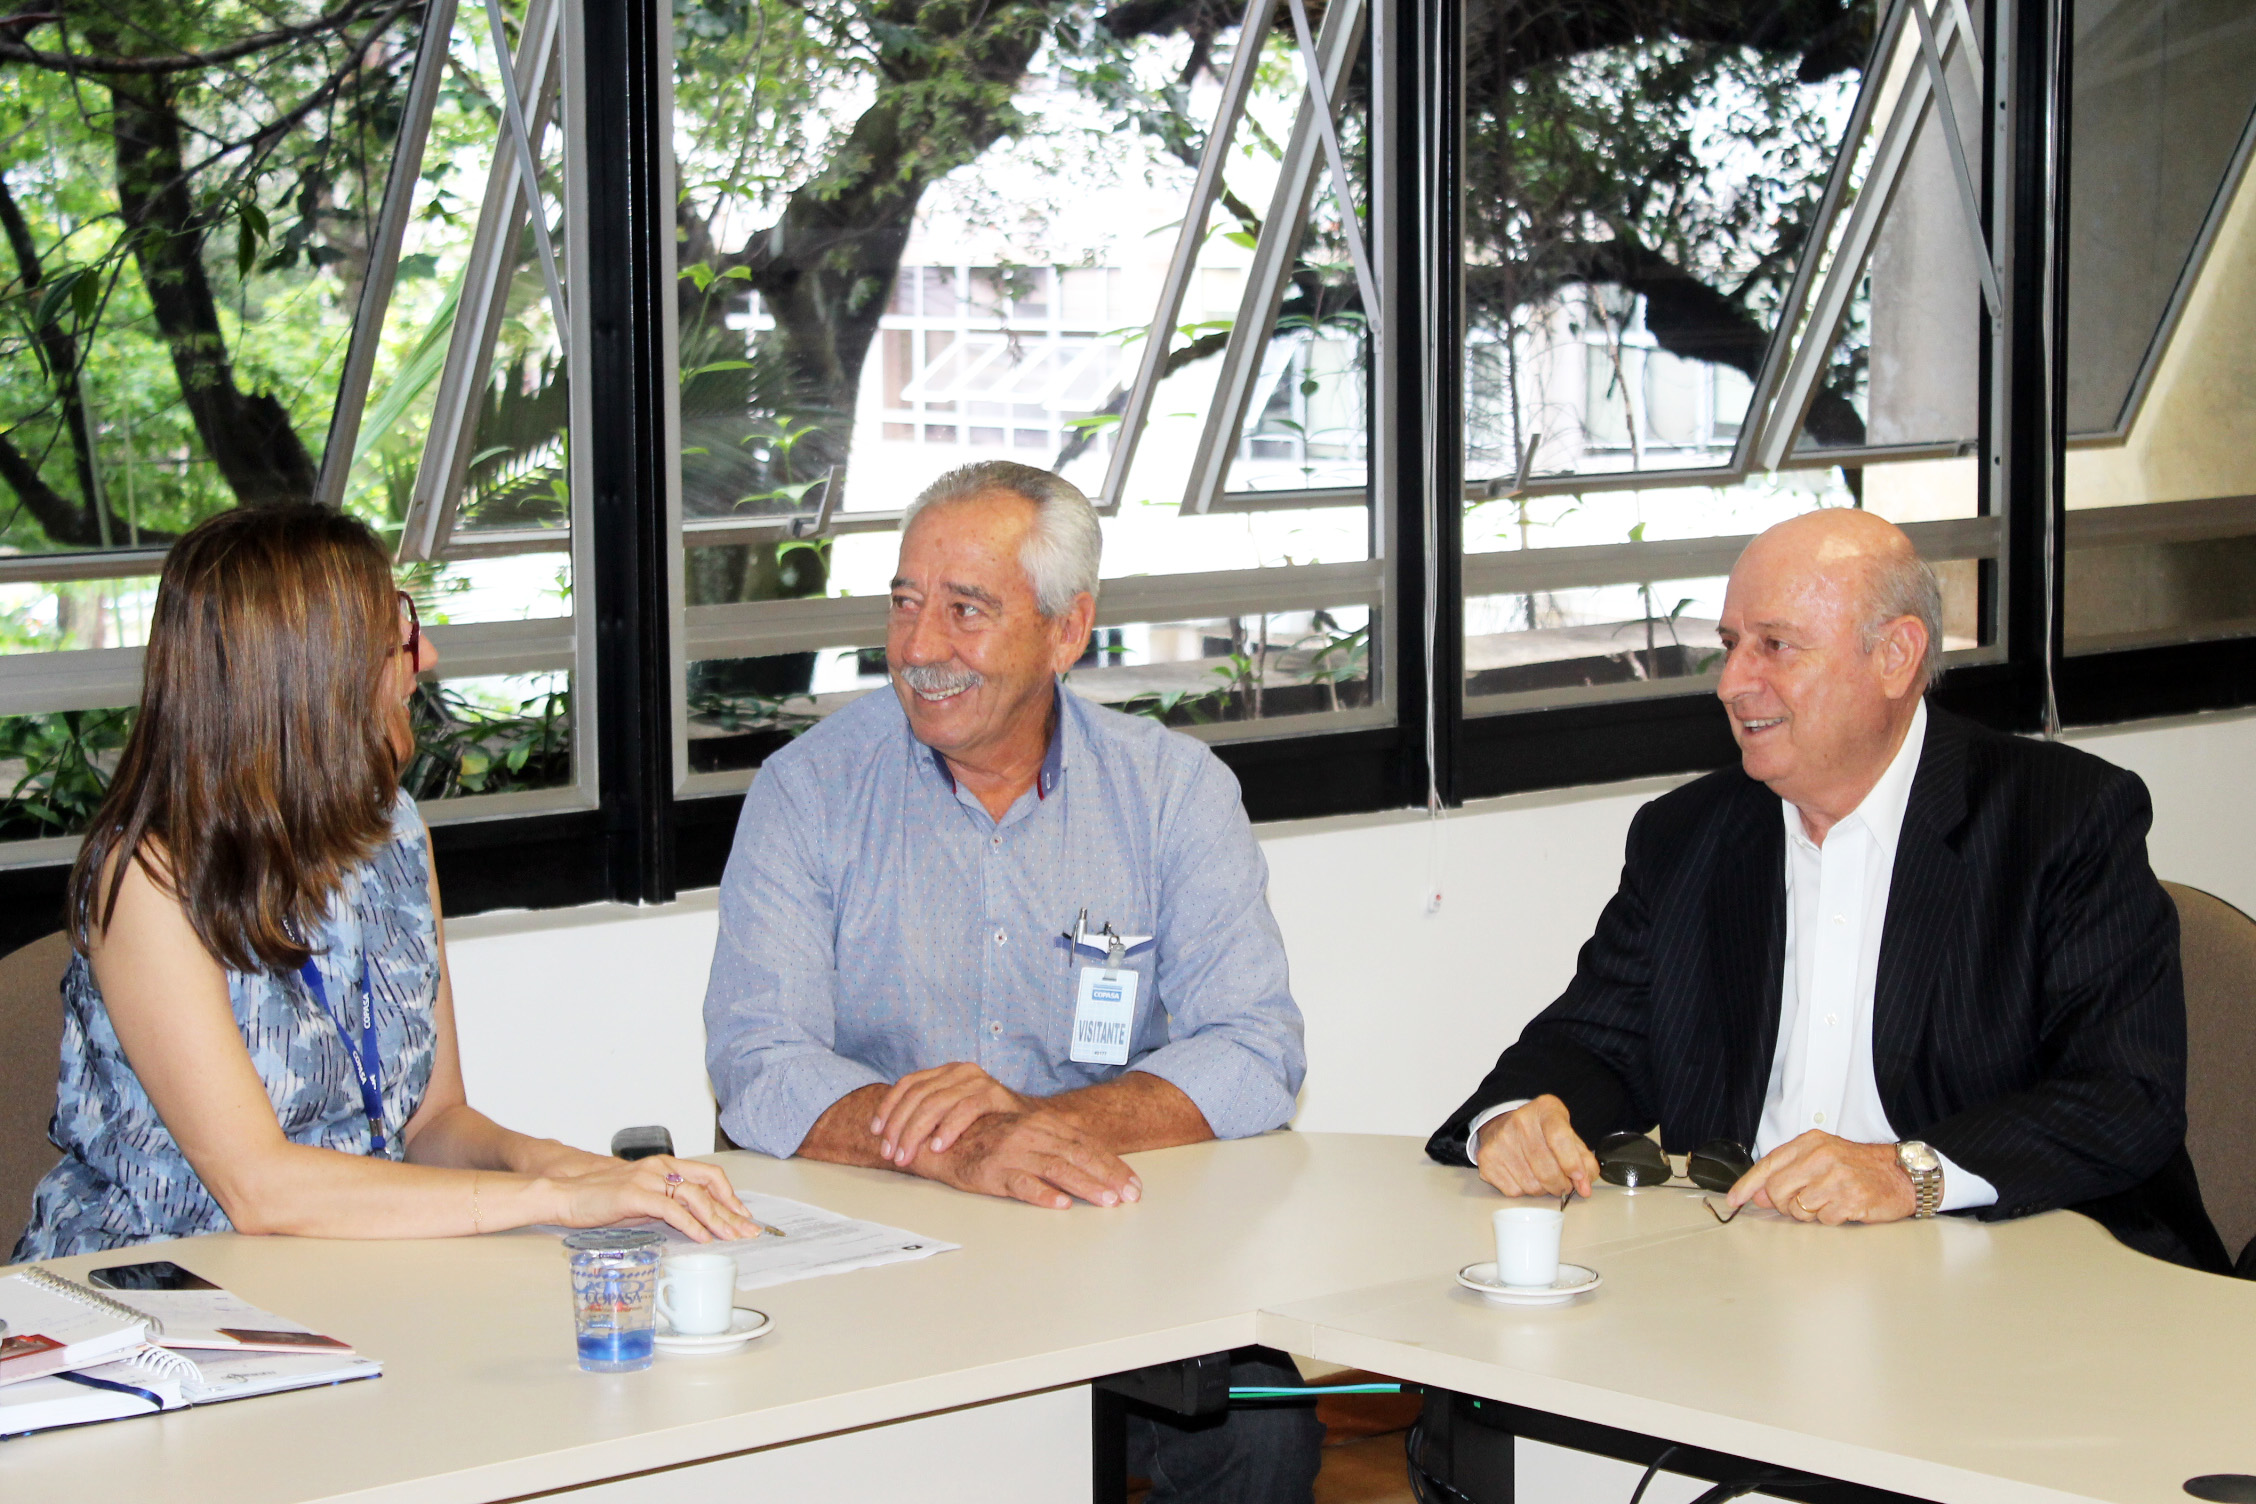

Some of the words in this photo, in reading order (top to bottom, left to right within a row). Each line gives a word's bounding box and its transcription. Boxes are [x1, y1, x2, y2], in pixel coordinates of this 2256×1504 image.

[1094, 991, 1120, 999] COPASA
[1078, 1020, 1126, 1045] VISITANTE
[352, 1050, 367, 1085] COPASA
